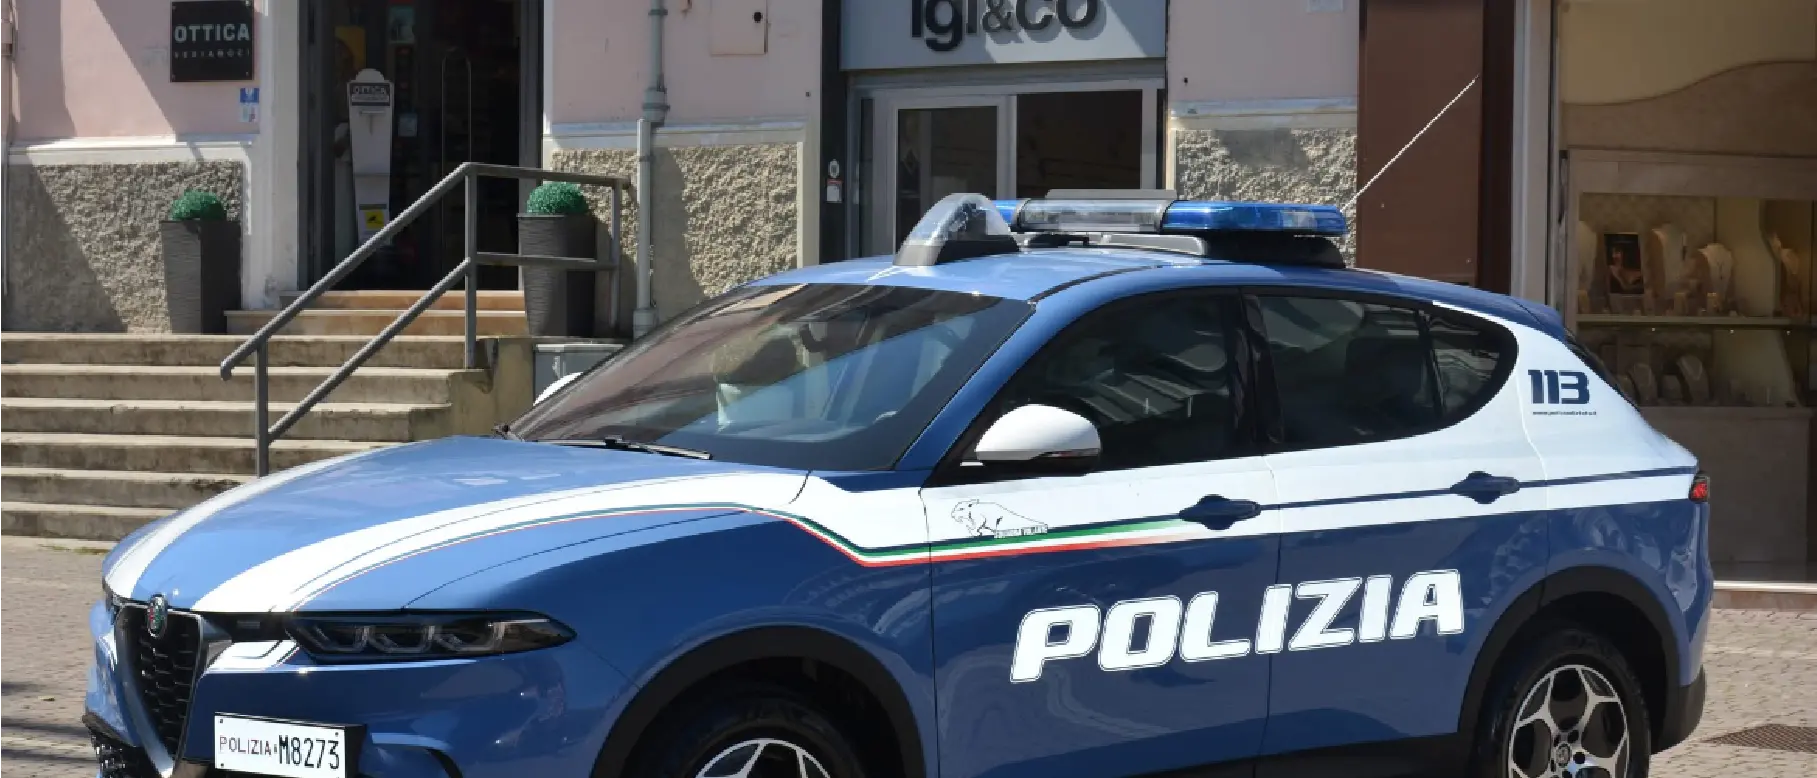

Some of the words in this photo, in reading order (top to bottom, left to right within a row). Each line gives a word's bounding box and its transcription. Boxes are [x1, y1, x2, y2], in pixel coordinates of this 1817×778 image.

[174, 23, 250, 42] OTTICA
[1527, 369, 1590, 404] 113
[1010, 568, 1464, 683] POLIZIA
[219, 733, 272, 756] POLIZIA
[278, 734, 340, 770] M8273
